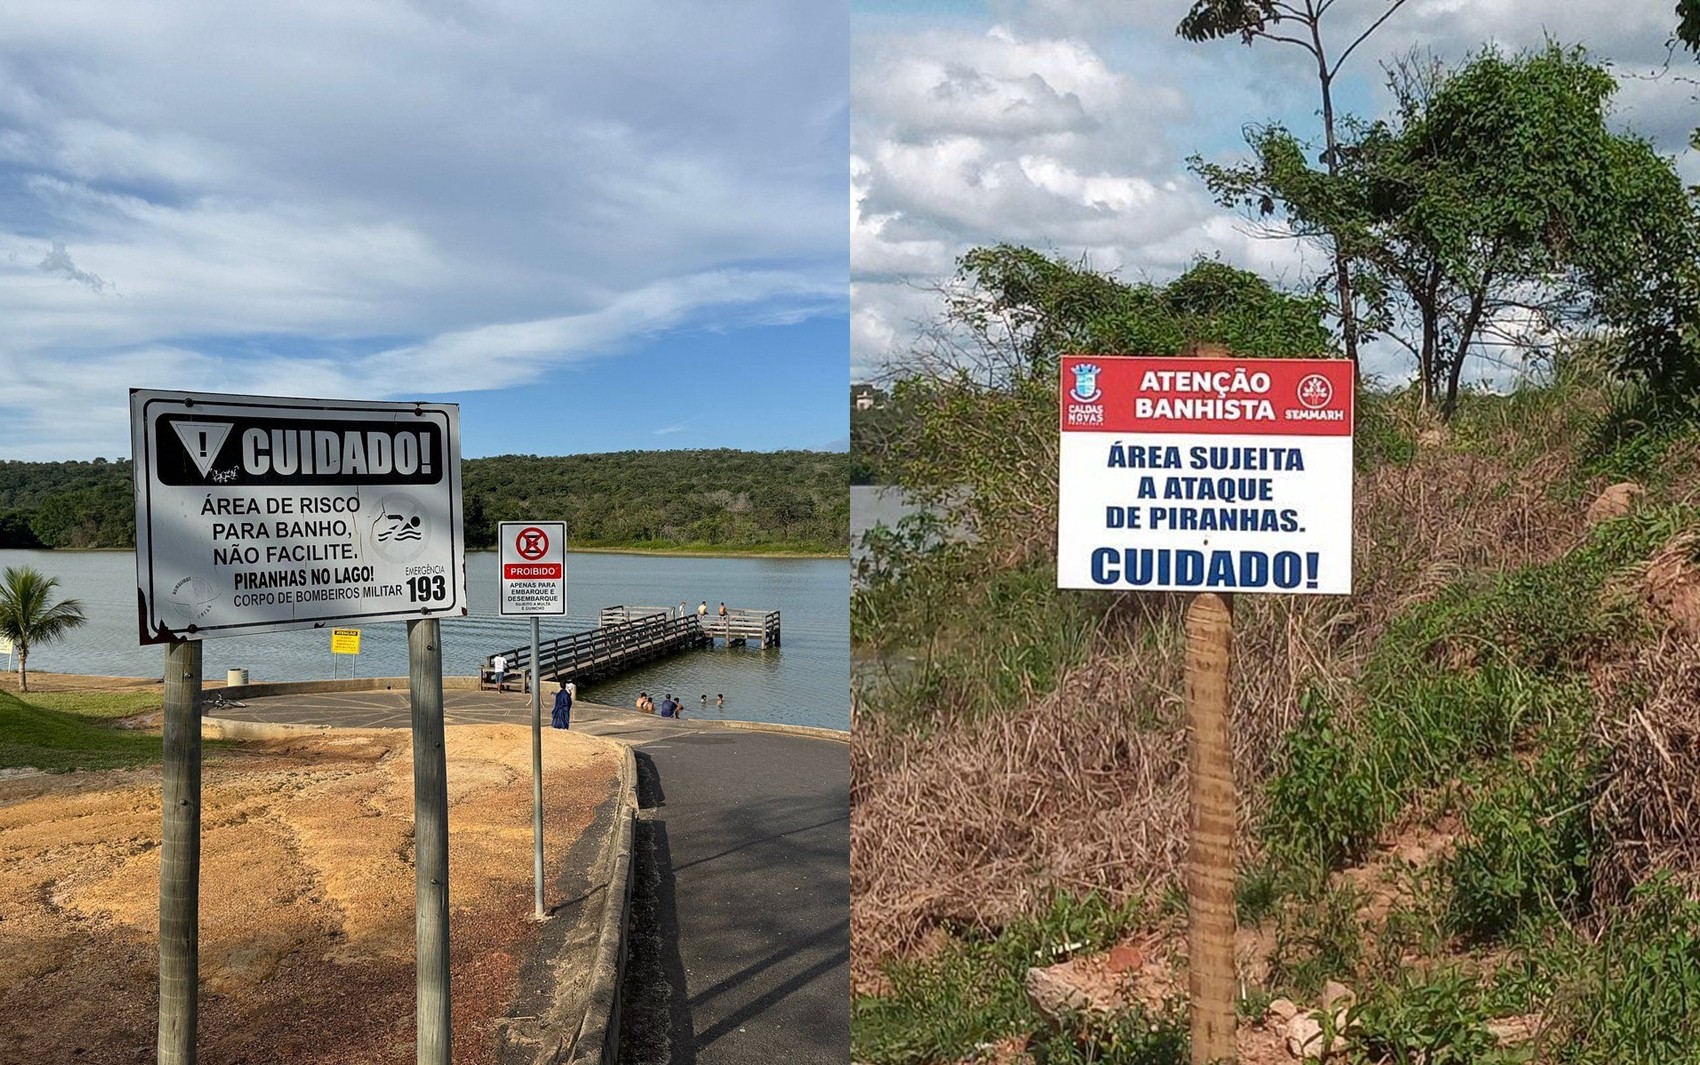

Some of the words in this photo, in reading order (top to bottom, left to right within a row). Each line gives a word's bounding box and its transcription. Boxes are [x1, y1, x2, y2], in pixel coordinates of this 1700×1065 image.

[1140, 367, 1271, 398] ATENÇÃO
[1068, 404, 1104, 413] CALDAS
[1068, 413, 1104, 422] NOVAS
[1135, 398, 1276, 421] BANHISTA
[1285, 409, 1344, 421] SEMMARH
[242, 428, 431, 476] CUIDADO!
[1107, 440, 1182, 469] ÁREA
[1190, 446, 1305, 471] SUJEITA
[1137, 476, 1157, 499] A
[1163, 477, 1273, 503] ATAQUE
[201, 493, 261, 515] ÁREA
[266, 497, 293, 514] DE
[300, 496, 361, 513] RISCO
[212, 522, 270, 540] PARA
[275, 520, 352, 539] BANHO,
[1106, 506, 1141, 529] DE
[1150, 507, 1305, 532] PIRANHAS.
[213, 543, 259, 566] NÃO
[266, 543, 358, 563] FACILITE.
[234, 569, 306, 590] PIRANHAS
[311, 567, 330, 585] NO
[335, 566, 374, 584] LAGO!
[405, 563, 445, 576] EMERGÊNCIA
[510, 567, 556, 576] PROIBIDO
[1090, 547, 1319, 589] CUIDADO!
[233, 592, 275, 607] CORPO
[278, 591, 293, 604] DE
[295, 587, 360, 603] BOMBEIROS
[363, 584, 403, 598] MILITAR
[406, 575, 446, 602] 193
